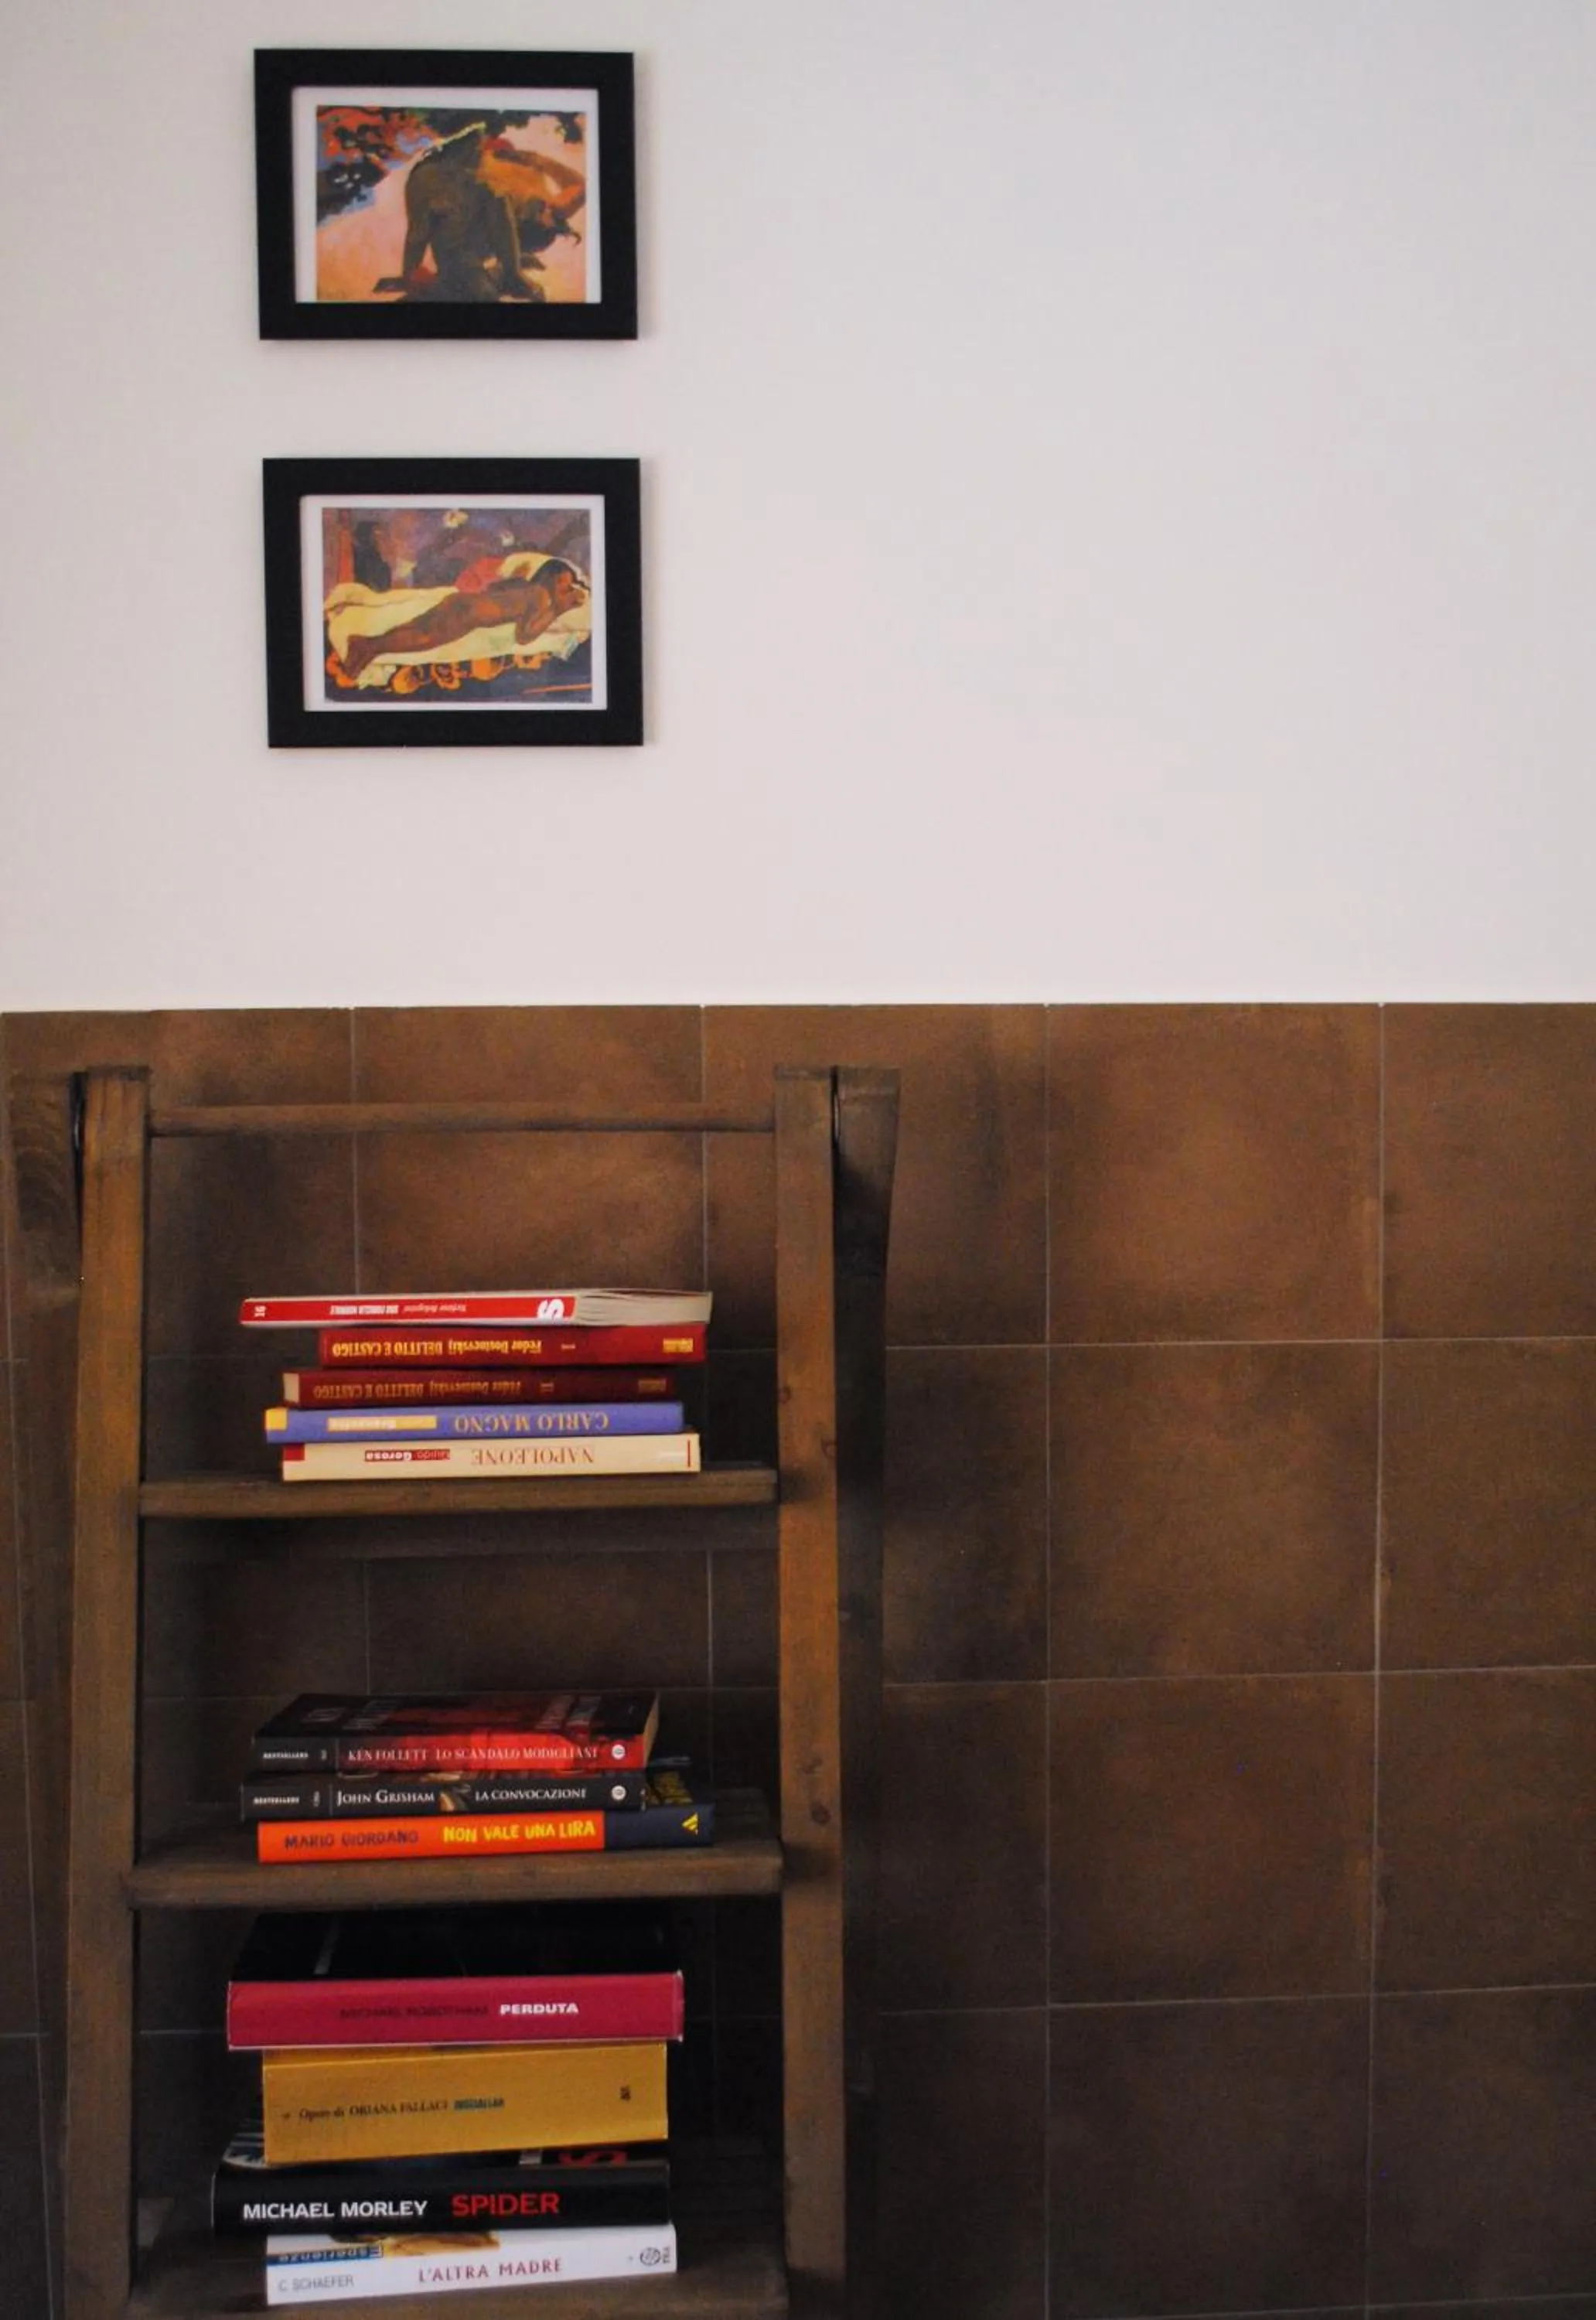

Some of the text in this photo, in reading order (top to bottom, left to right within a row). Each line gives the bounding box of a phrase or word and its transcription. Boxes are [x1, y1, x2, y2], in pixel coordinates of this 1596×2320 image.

[332, 1342, 381, 1357] CASTIGO
[385, 1342, 391, 1356] E
[394, 1340, 442, 1356] DELITTO
[314, 1384, 363, 1399] CASTIGO
[375, 1383, 425, 1397] DELITTO
[454, 1411, 609, 1433] CARLO MAGNO
[366, 1450, 413, 1461] Gerosa
[471, 1448, 594, 1465] NAPOLEONE
[348, 1746, 598, 1762] KEN FOLLETT LO SCANDALO MODIGLIANI
[475, 1792, 489, 1801] LA
[491, 1788, 587, 1800] CONVOCAZIONE
[285, 1820, 596, 1850] MARIO GIORDANO NON VALE UNA LIRA
[500, 2003, 578, 2015] PERDUTA
[350, 2103, 396, 2117] ORIANA
[400, 2100, 448, 2114] FALLACI
[243, 2192, 561, 2219] MICHAEL MORLEY SPIDER
[292, 2275, 354, 2291] SCHAEFER
[418, 2265, 489, 2283] L'ALTRA
[499, 2257, 562, 2276] MADRE
